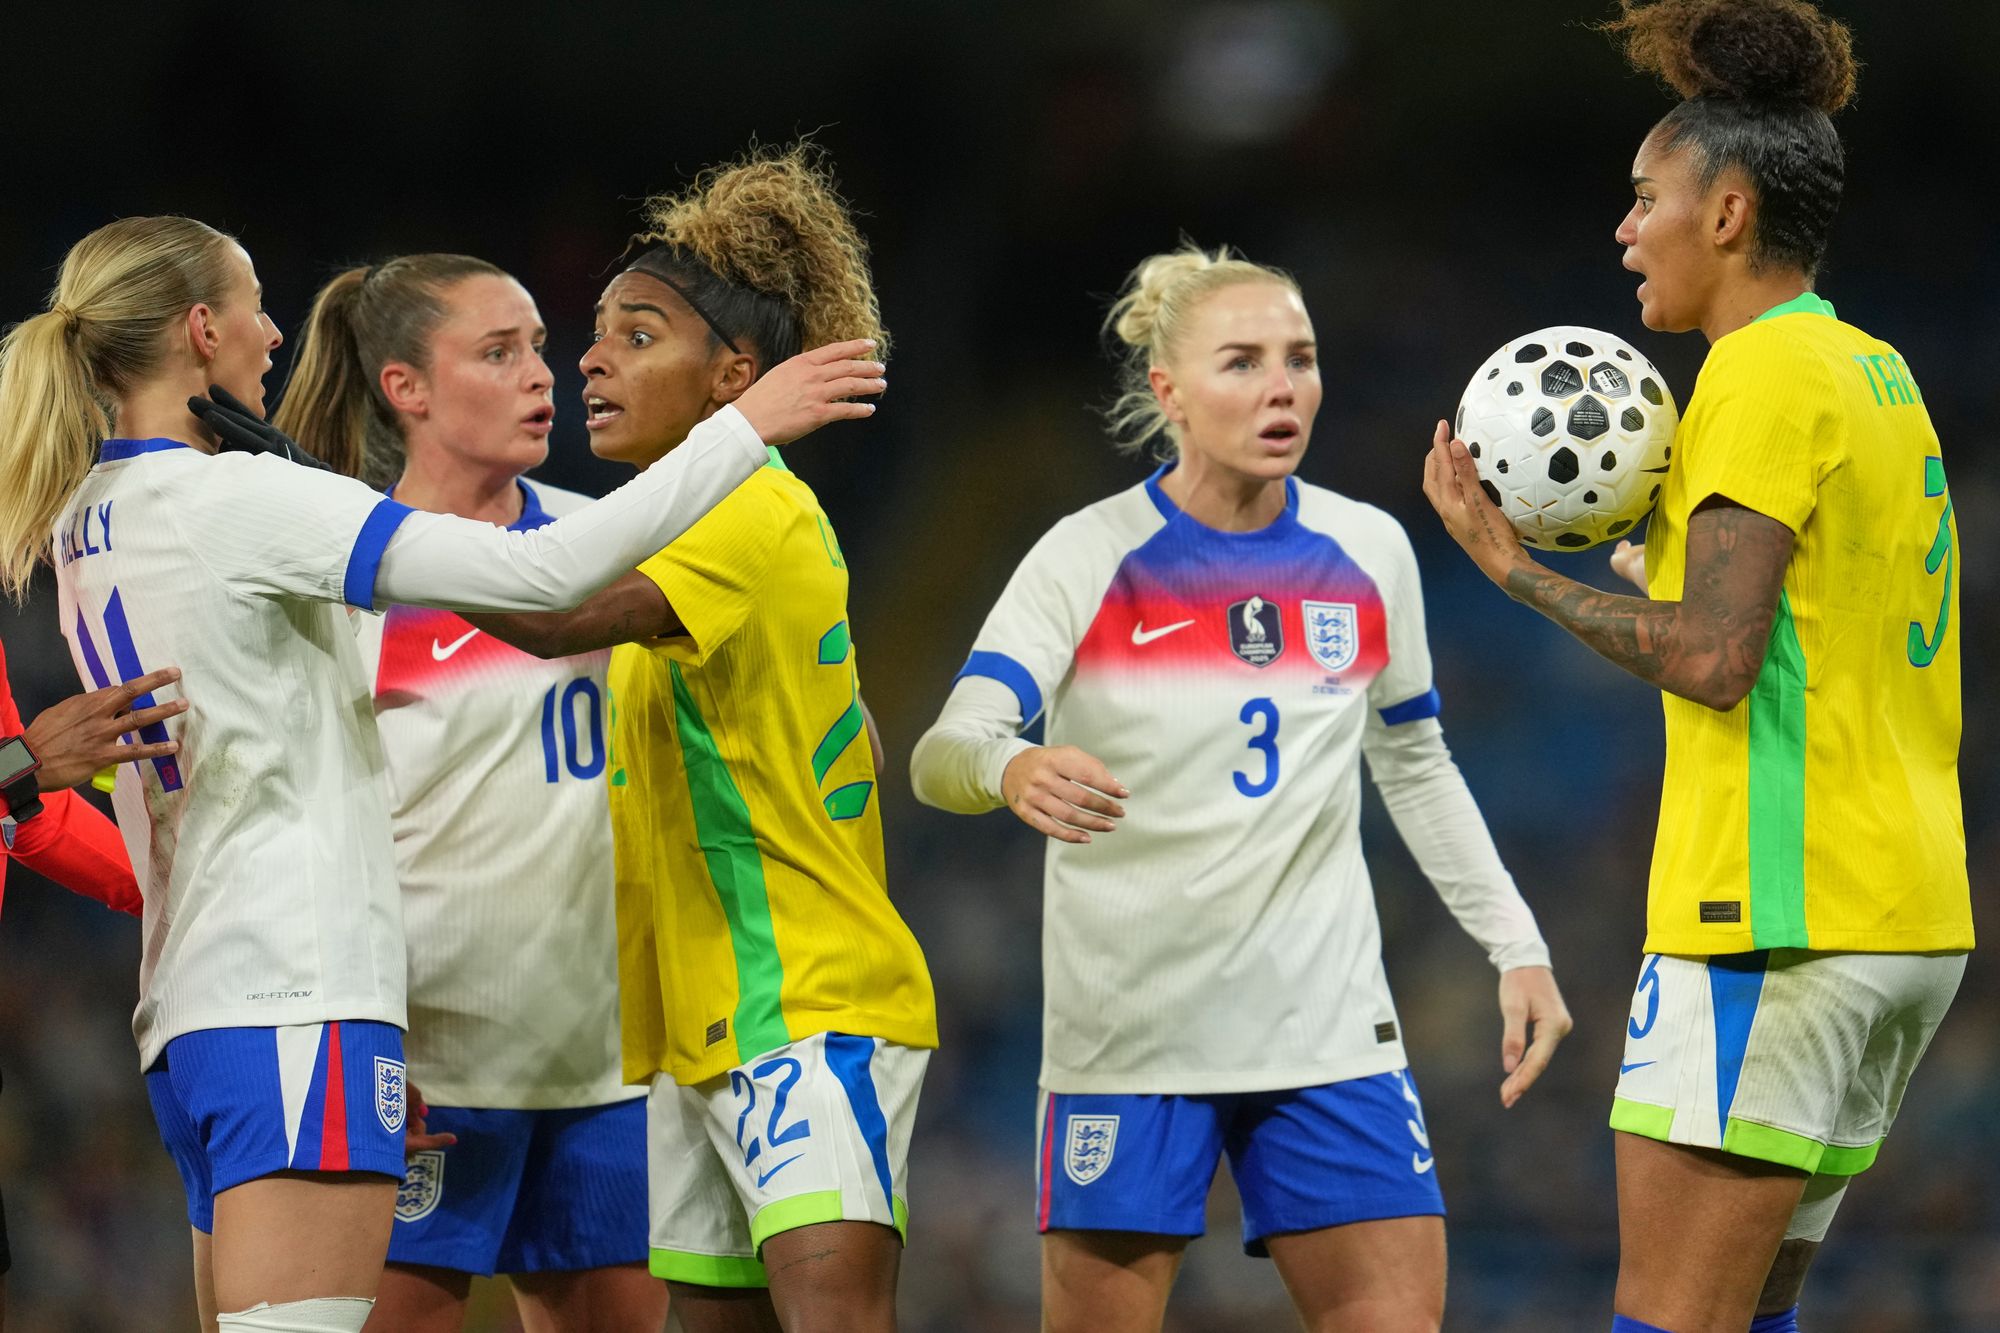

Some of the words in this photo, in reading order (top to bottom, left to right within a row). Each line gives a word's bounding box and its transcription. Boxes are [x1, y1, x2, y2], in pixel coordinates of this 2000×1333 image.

[1907, 455, 1953, 668] 3
[76, 584, 183, 793] 11
[541, 676, 606, 784] 10
[1232, 697, 1280, 798] 3
[730, 1057, 811, 1168] 22
